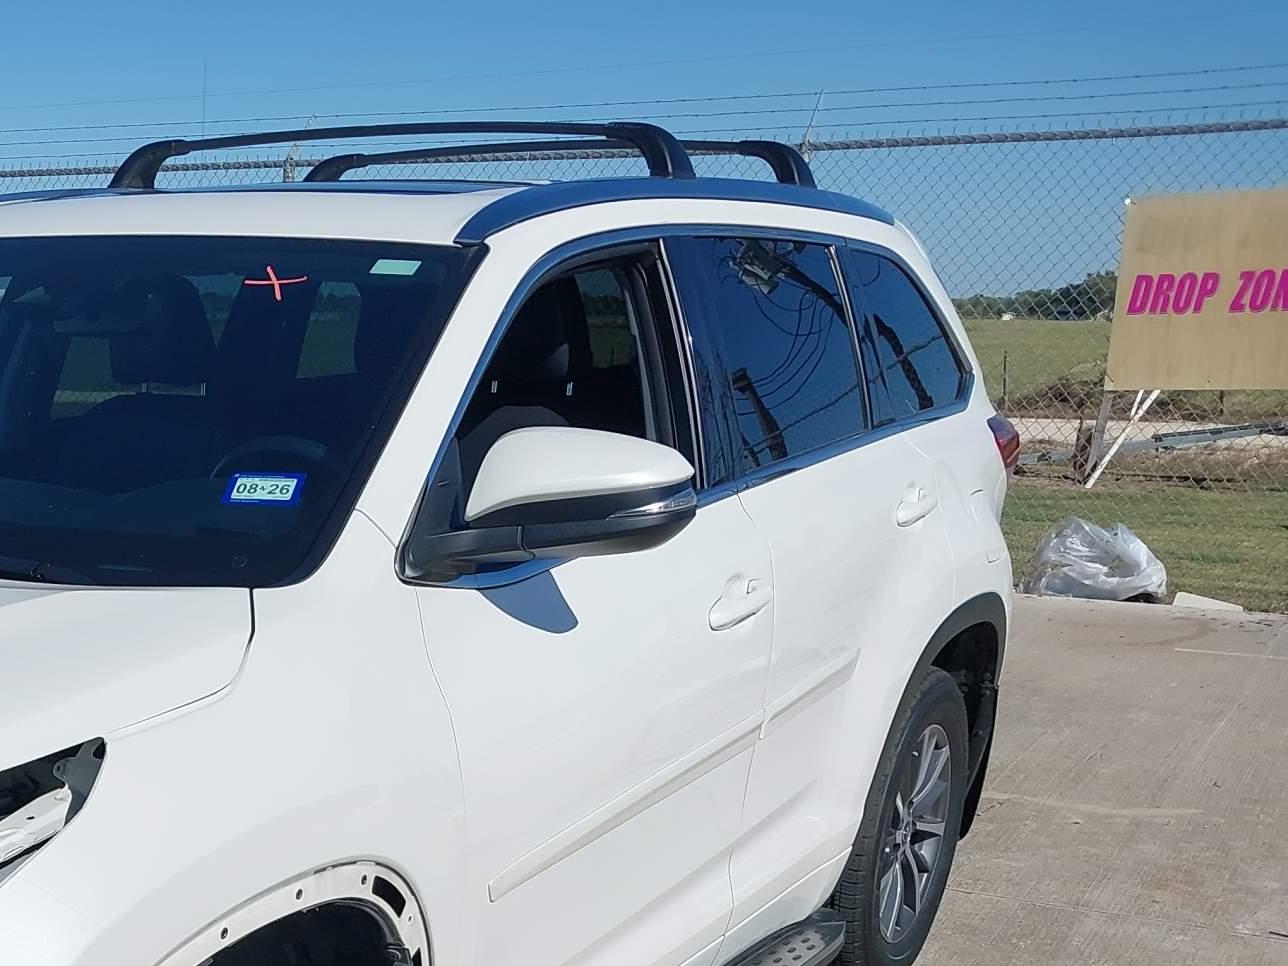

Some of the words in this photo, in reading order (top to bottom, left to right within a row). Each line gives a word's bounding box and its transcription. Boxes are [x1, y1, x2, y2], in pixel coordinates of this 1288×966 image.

[1127, 271, 1220, 315] DROP
[235, 482, 259, 495] 08
[266, 483, 291, 496] 26
